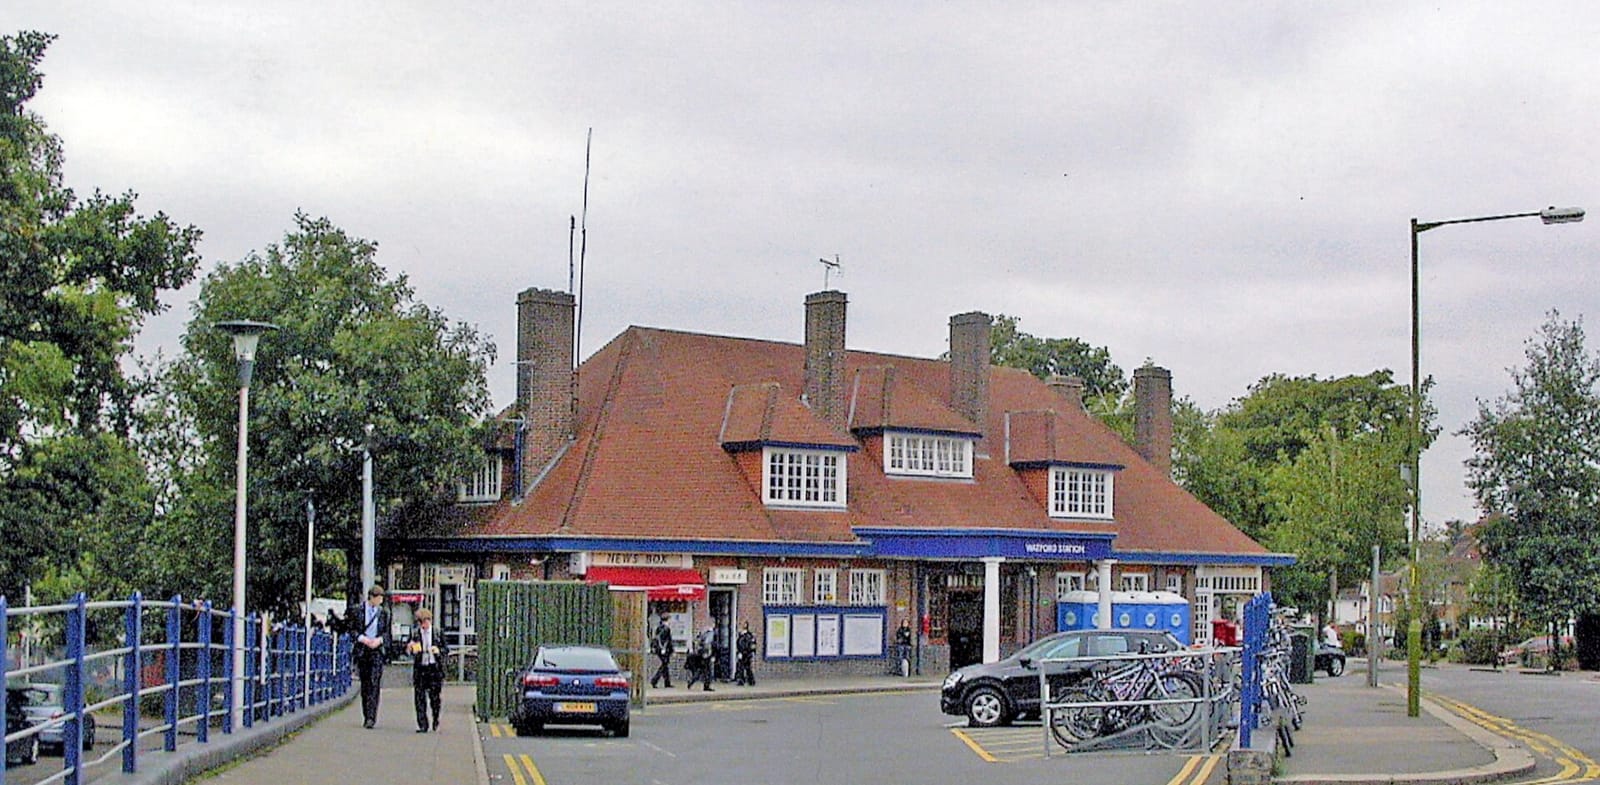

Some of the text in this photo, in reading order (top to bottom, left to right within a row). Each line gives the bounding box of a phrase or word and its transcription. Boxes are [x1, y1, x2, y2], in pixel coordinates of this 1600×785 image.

[1025, 543, 1085, 554] WATFORD STATION
[607, 552, 667, 564] NEWS BOX
